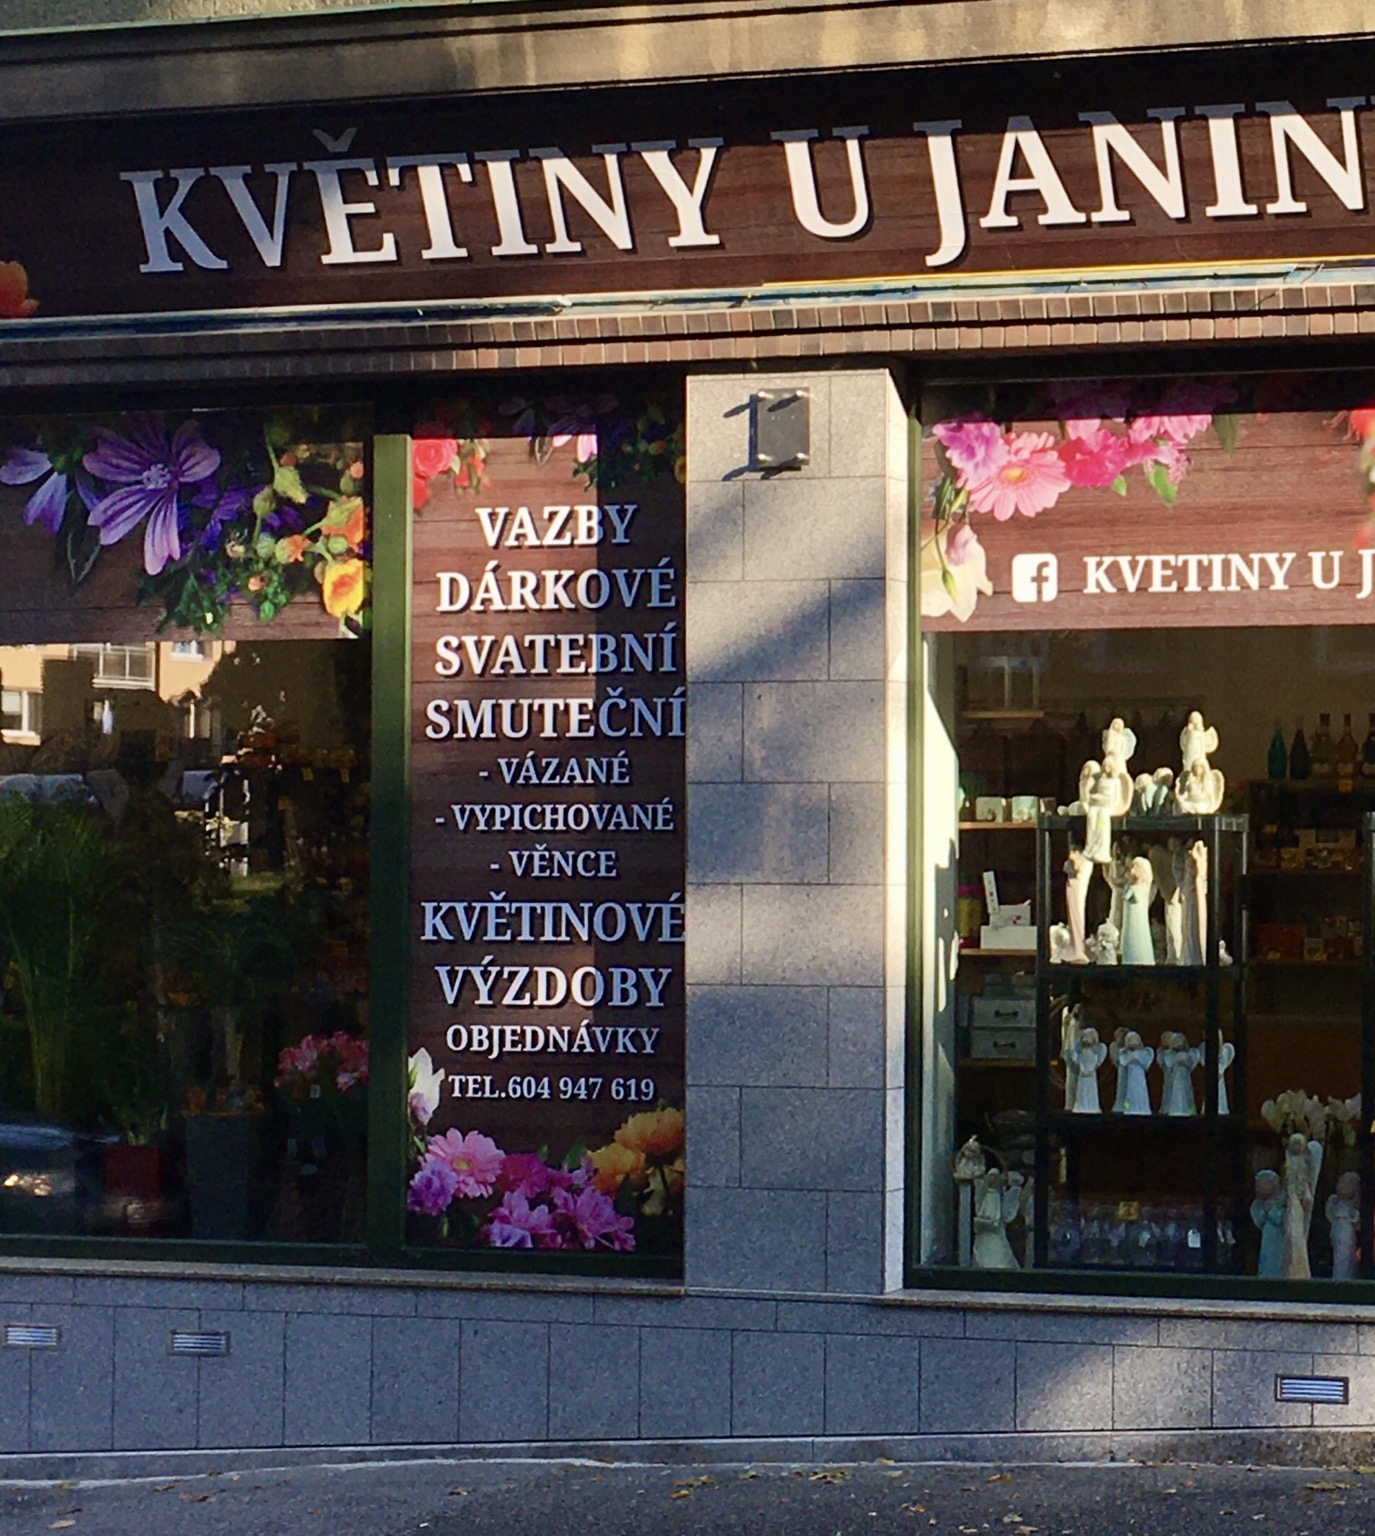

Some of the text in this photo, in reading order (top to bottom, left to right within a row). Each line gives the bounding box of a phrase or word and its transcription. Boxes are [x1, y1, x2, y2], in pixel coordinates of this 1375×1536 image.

[119, 127, 724, 273] KVĚTINY
[770, 125, 869, 238] U
[475, 504, 638, 547] VAZBY
[435, 557, 676, 612] DÁRKOVÉ
[1082, 553, 1296, 595] KVETINY
[1306, 550, 1344, 589] U
[434, 621, 677, 677] SVATEBNÍ
[425, 686, 686, 739] SMUTEČNÍ
[497, 750, 631, 785] VÁZANÉ
[451, 797, 675, 831] VYPICHOVANÉ
[508, 843, 617, 878] VĚNCE
[420, 891, 686, 942] KVĚTINOVÉ
[434, 955, 672, 1007] VÝZDOBY
[446, 1019, 660, 1059] OBJEDNÁVKY
[559, 1077, 602, 1100] 947
[610, 1078, 654, 1101] 619
